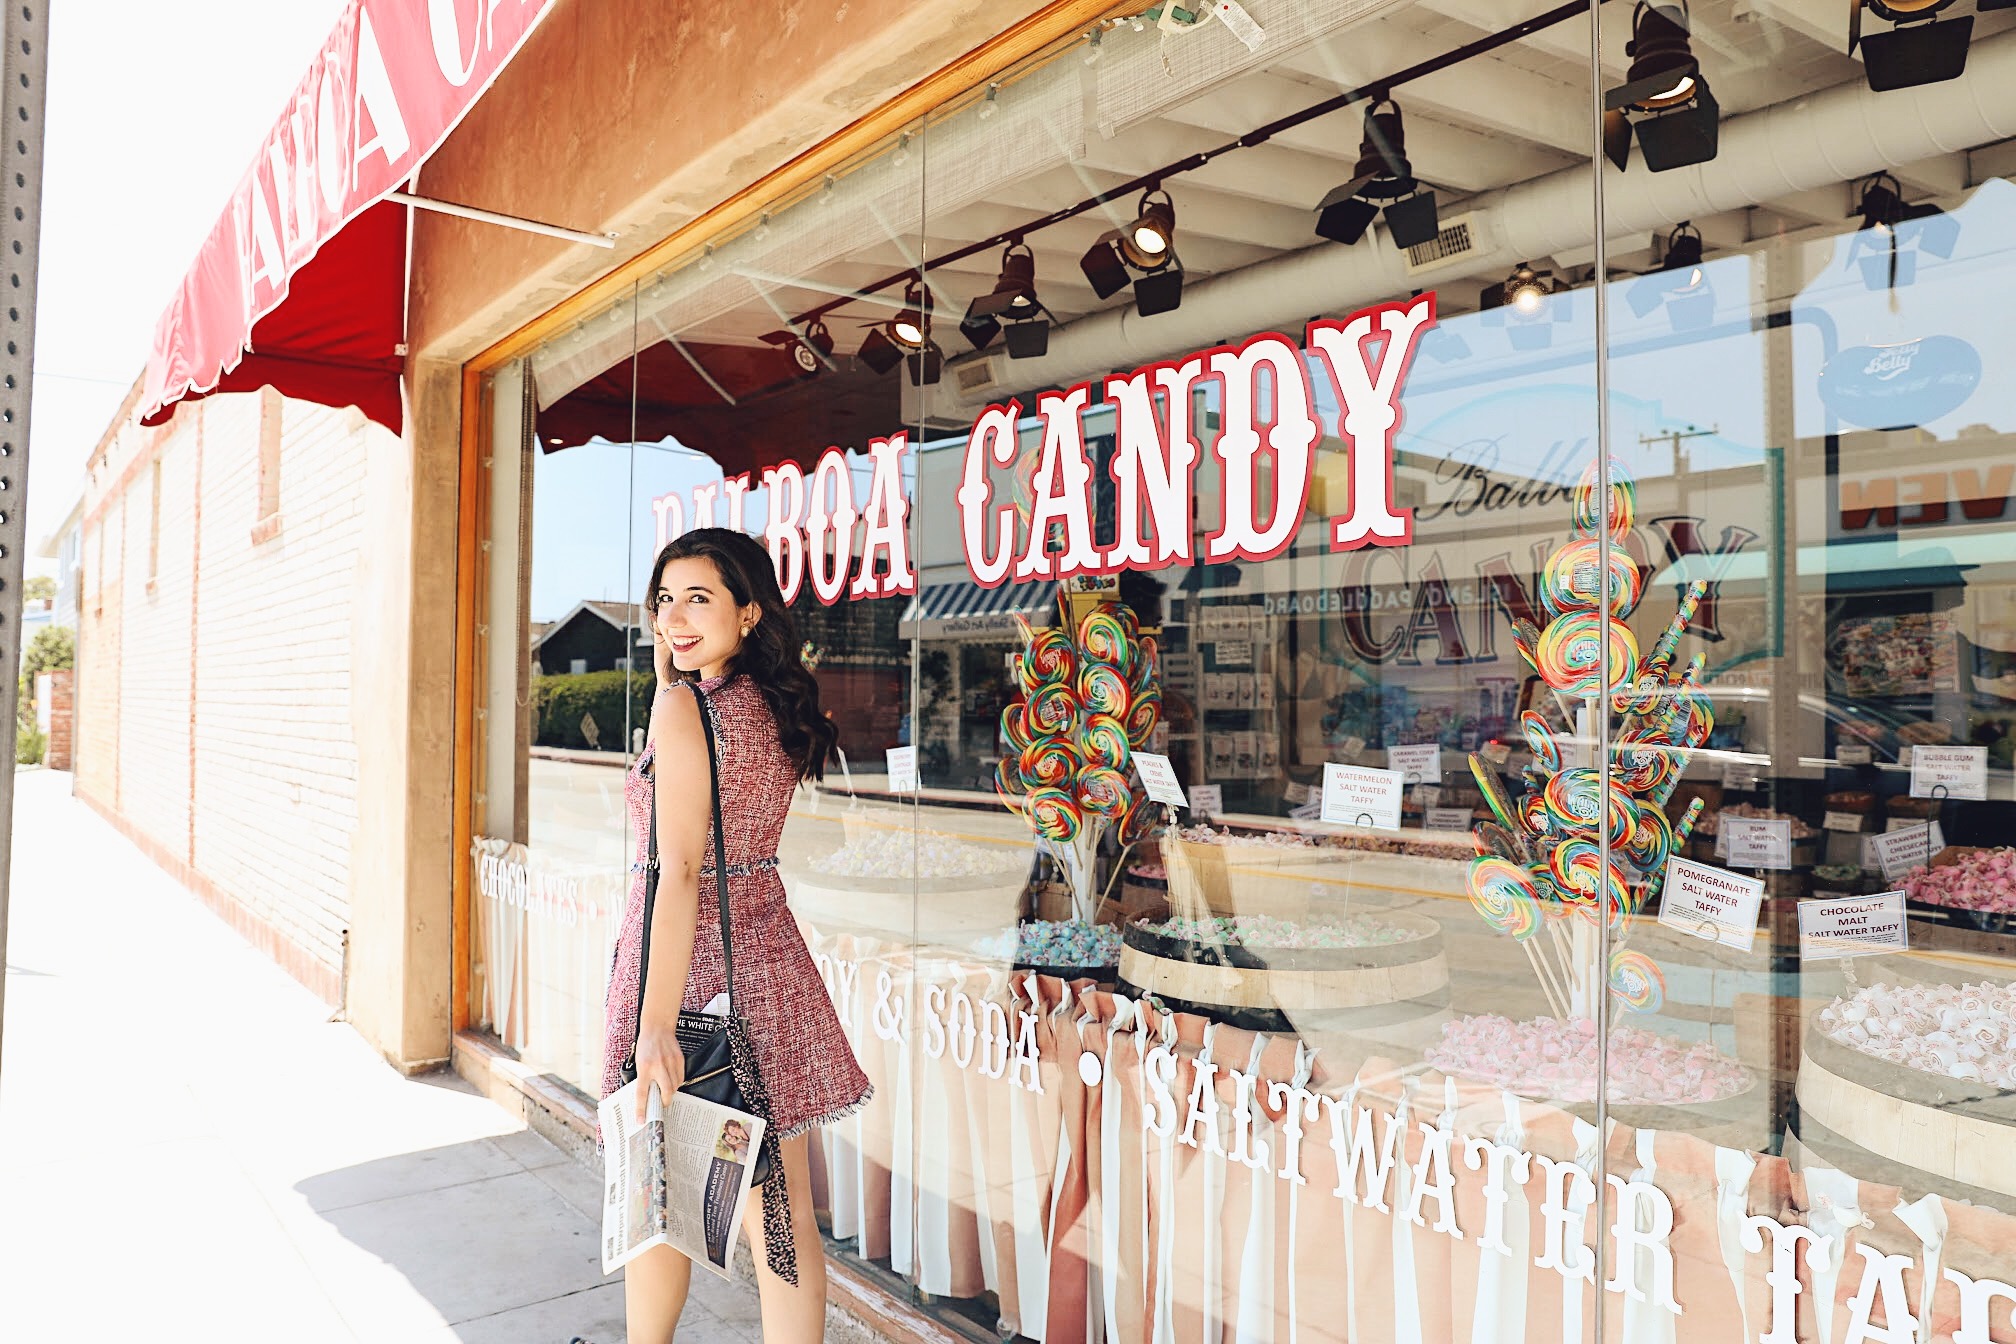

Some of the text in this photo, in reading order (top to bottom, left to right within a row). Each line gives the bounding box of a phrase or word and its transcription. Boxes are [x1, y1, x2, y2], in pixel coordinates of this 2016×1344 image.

[1864, 355, 1911, 376] Belly
[957, 290, 1437, 590] CANDY
[1336, 772, 1393, 785] WATERMELON
[1340, 783, 1387, 795] SALT WATER
[1351, 795, 1374, 805] TAFFY
[1677, 867, 1751, 897] POMEGRANATE
[1681, 882, 1738, 907] SALT WATER
[1695, 900, 1722, 916] TAFFY
[1820, 902, 1884, 916] CHOCOLATE
[1838, 916, 1868, 926] MALT
[1808, 923, 1900, 939] SALT WATER TAFFY
[688, 1020, 714, 1032] WHITE
[923, 984, 1044, 1096] SODA
[613, 1103, 627, 1257] Newport Beach Independent
[708, 1160, 722, 1202] ACADEMY
